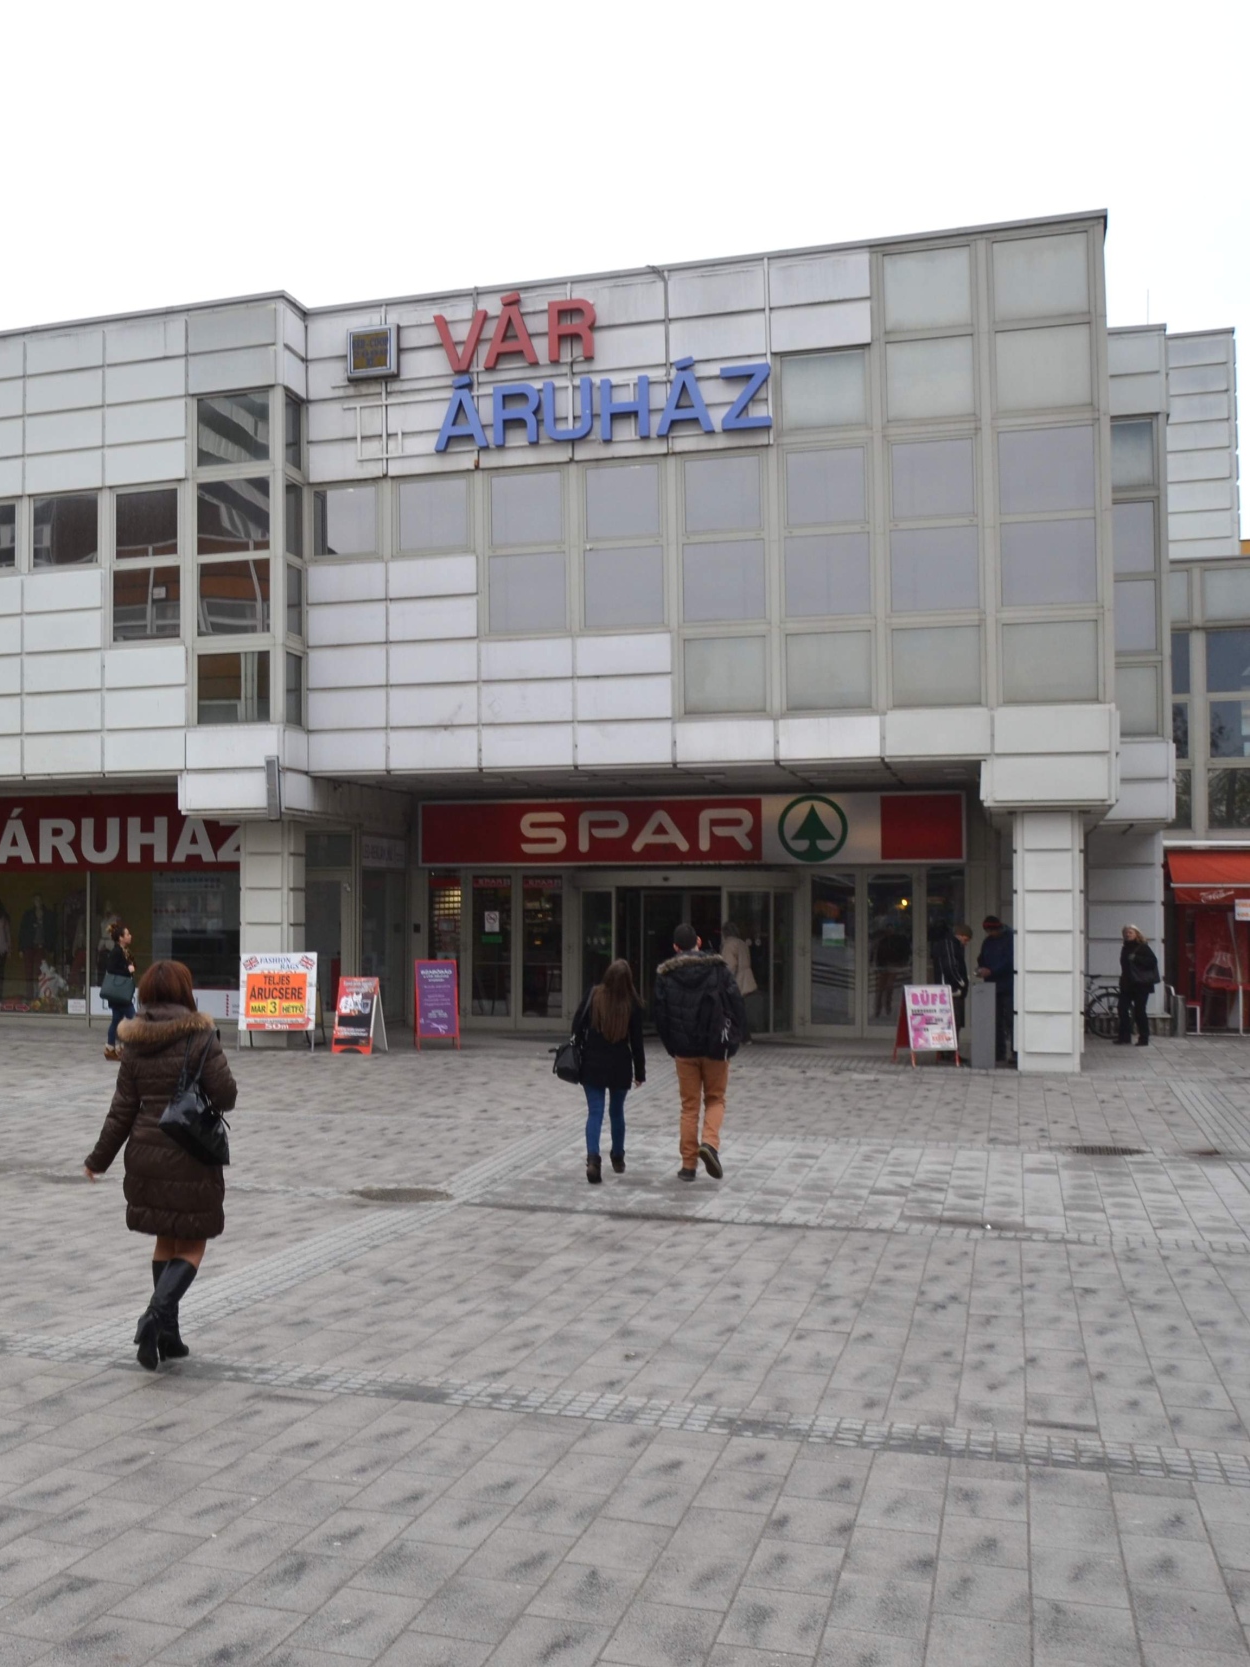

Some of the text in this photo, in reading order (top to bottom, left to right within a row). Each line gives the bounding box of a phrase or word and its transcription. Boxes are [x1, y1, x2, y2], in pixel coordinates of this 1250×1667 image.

[433, 291, 596, 373] VÁR
[435, 356, 772, 452] ÁRUHÁZ
[520, 808, 754, 854] SPAR
[260, 956, 291, 964] FASHION
[263, 975, 291, 985] TELJES
[250, 985, 303, 1000] ÁRUCSERE
[911, 990, 947, 1006] BÜFÉ
[269, 1001, 277, 1014] 3
